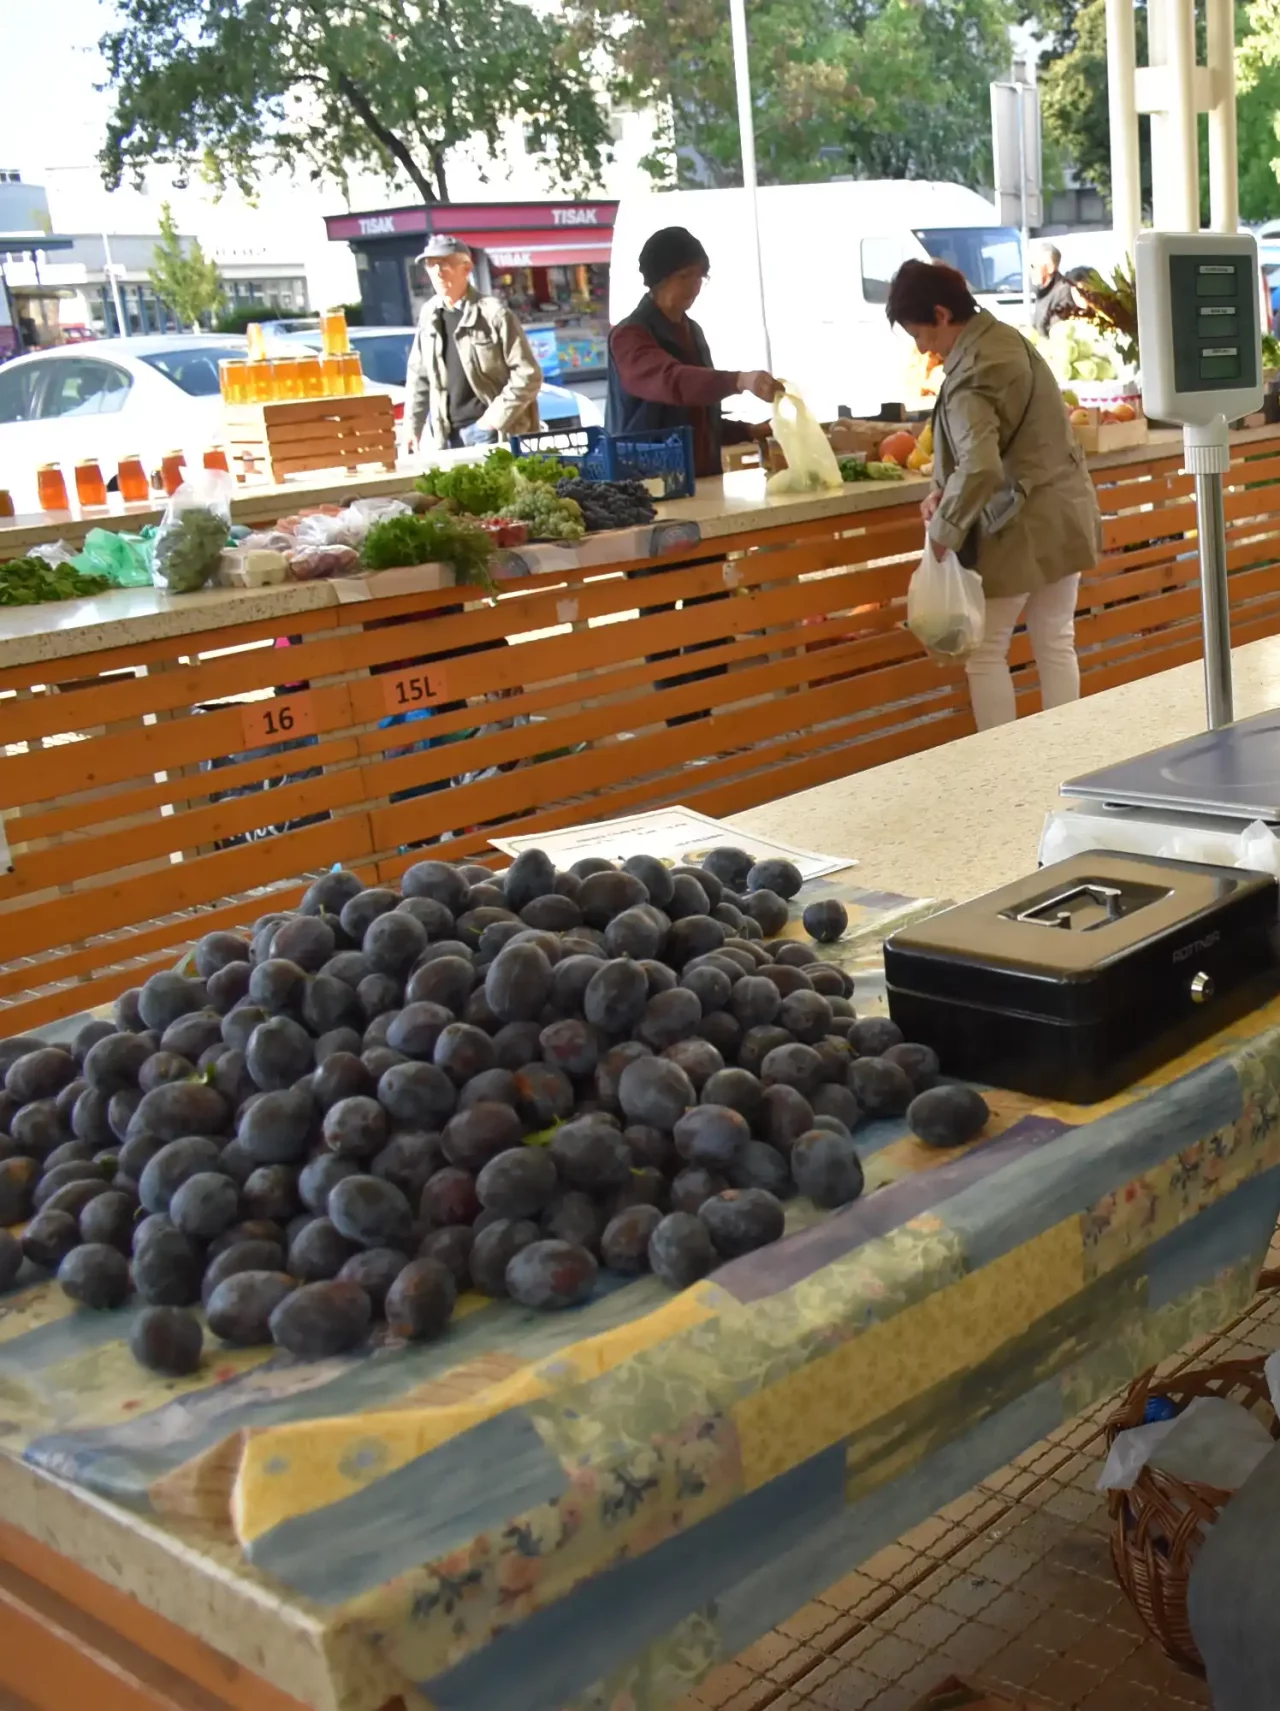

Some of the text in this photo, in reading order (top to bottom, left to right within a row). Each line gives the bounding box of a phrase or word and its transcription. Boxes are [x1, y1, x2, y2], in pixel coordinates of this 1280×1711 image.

[358, 215, 394, 235] TISAK
[551, 208, 597, 225] TISAK
[396, 676, 437, 705] 15L
[263, 706, 295, 735] 16
